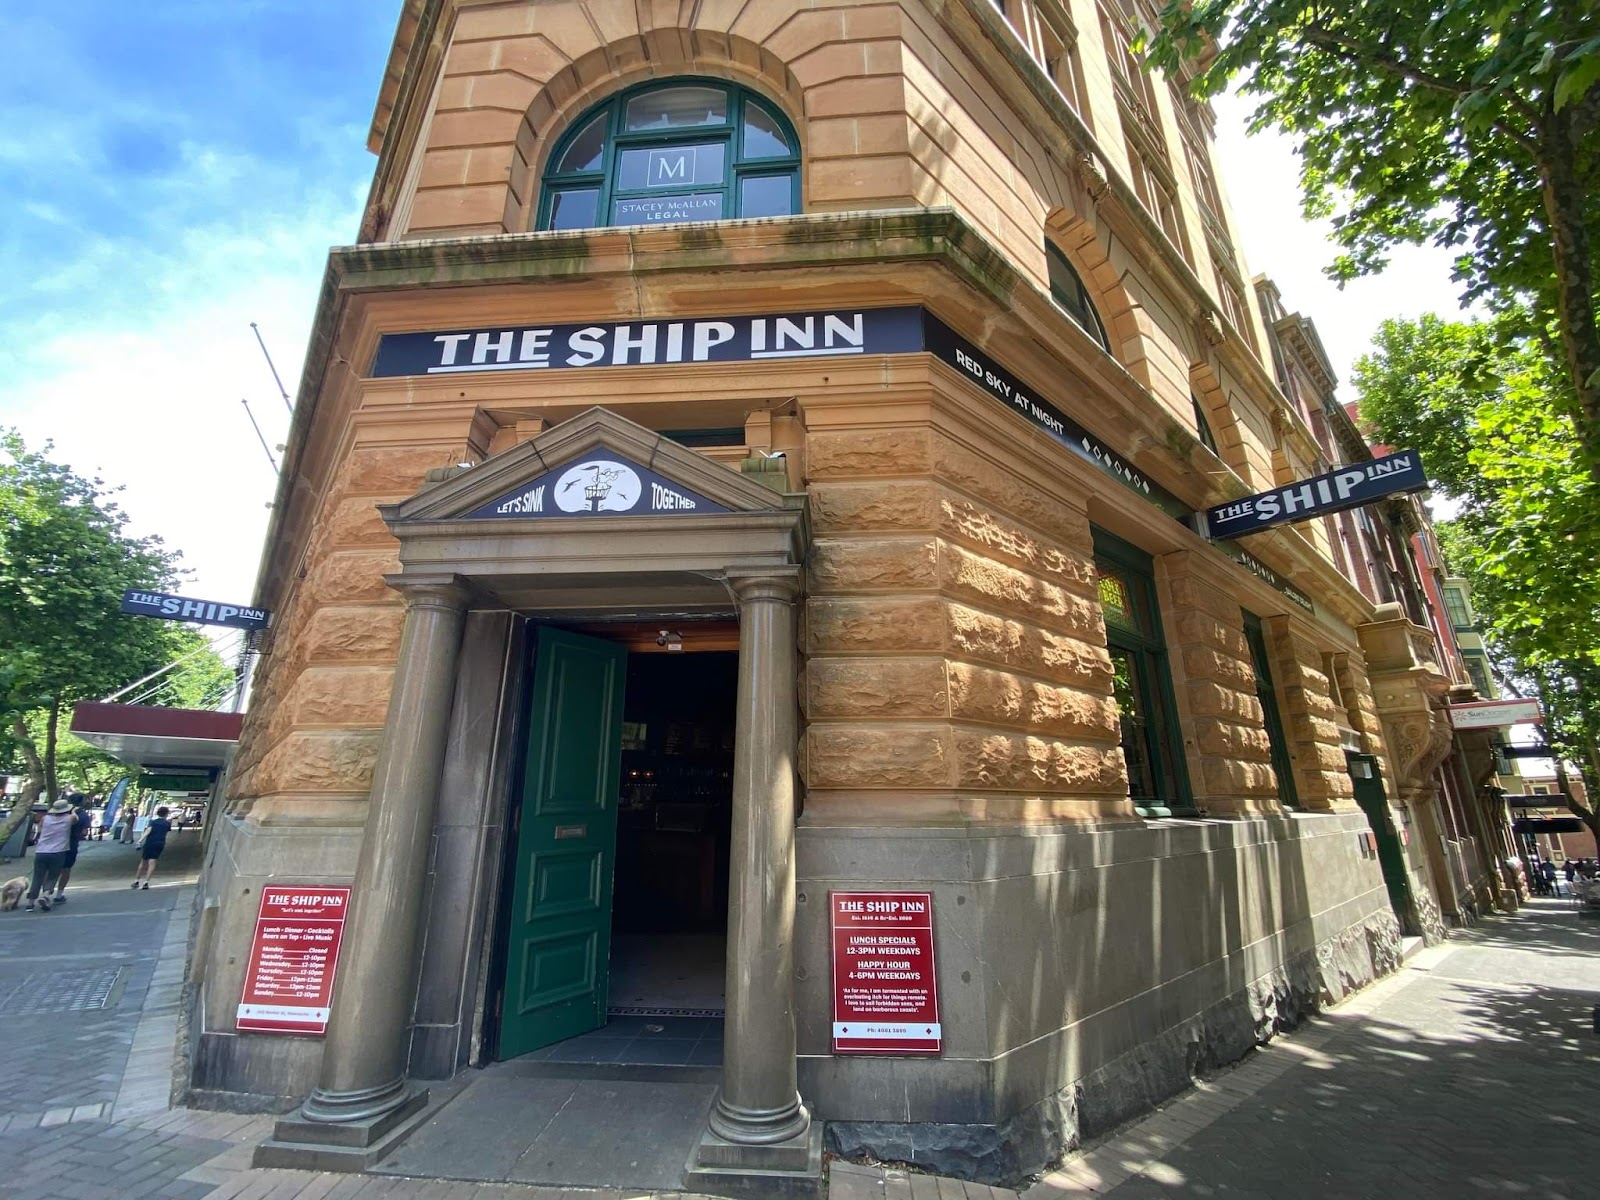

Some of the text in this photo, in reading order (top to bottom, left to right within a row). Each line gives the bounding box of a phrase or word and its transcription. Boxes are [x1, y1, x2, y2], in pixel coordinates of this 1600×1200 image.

[658, 156, 685, 179] M
[622, 199, 717, 213] STACEY McALLAN
[646, 210, 689, 220] LEGAL
[432, 313, 864, 367] THE SHIP INN
[955, 348, 1065, 435] RED SKY AT NIGHT
[1214, 455, 1412, 521] THE SHIP INN
[497, 484, 546, 514] LET'S SINK
[651, 482, 696, 510] TOGETHER
[130, 592, 265, 622] THE SHIP INN
[267, 894, 344, 906] THE SHIP INN
[839, 901, 925, 913] THE SHIP INN
[850, 936, 916, 944] LUNCH SPECIALS
[846, 947, 921, 955] 12-3PM WEEKDAYS
[857, 961, 911, 969] HAPPY HOUR
[848, 971, 921, 980] 4-6PM WEEKDAYS
